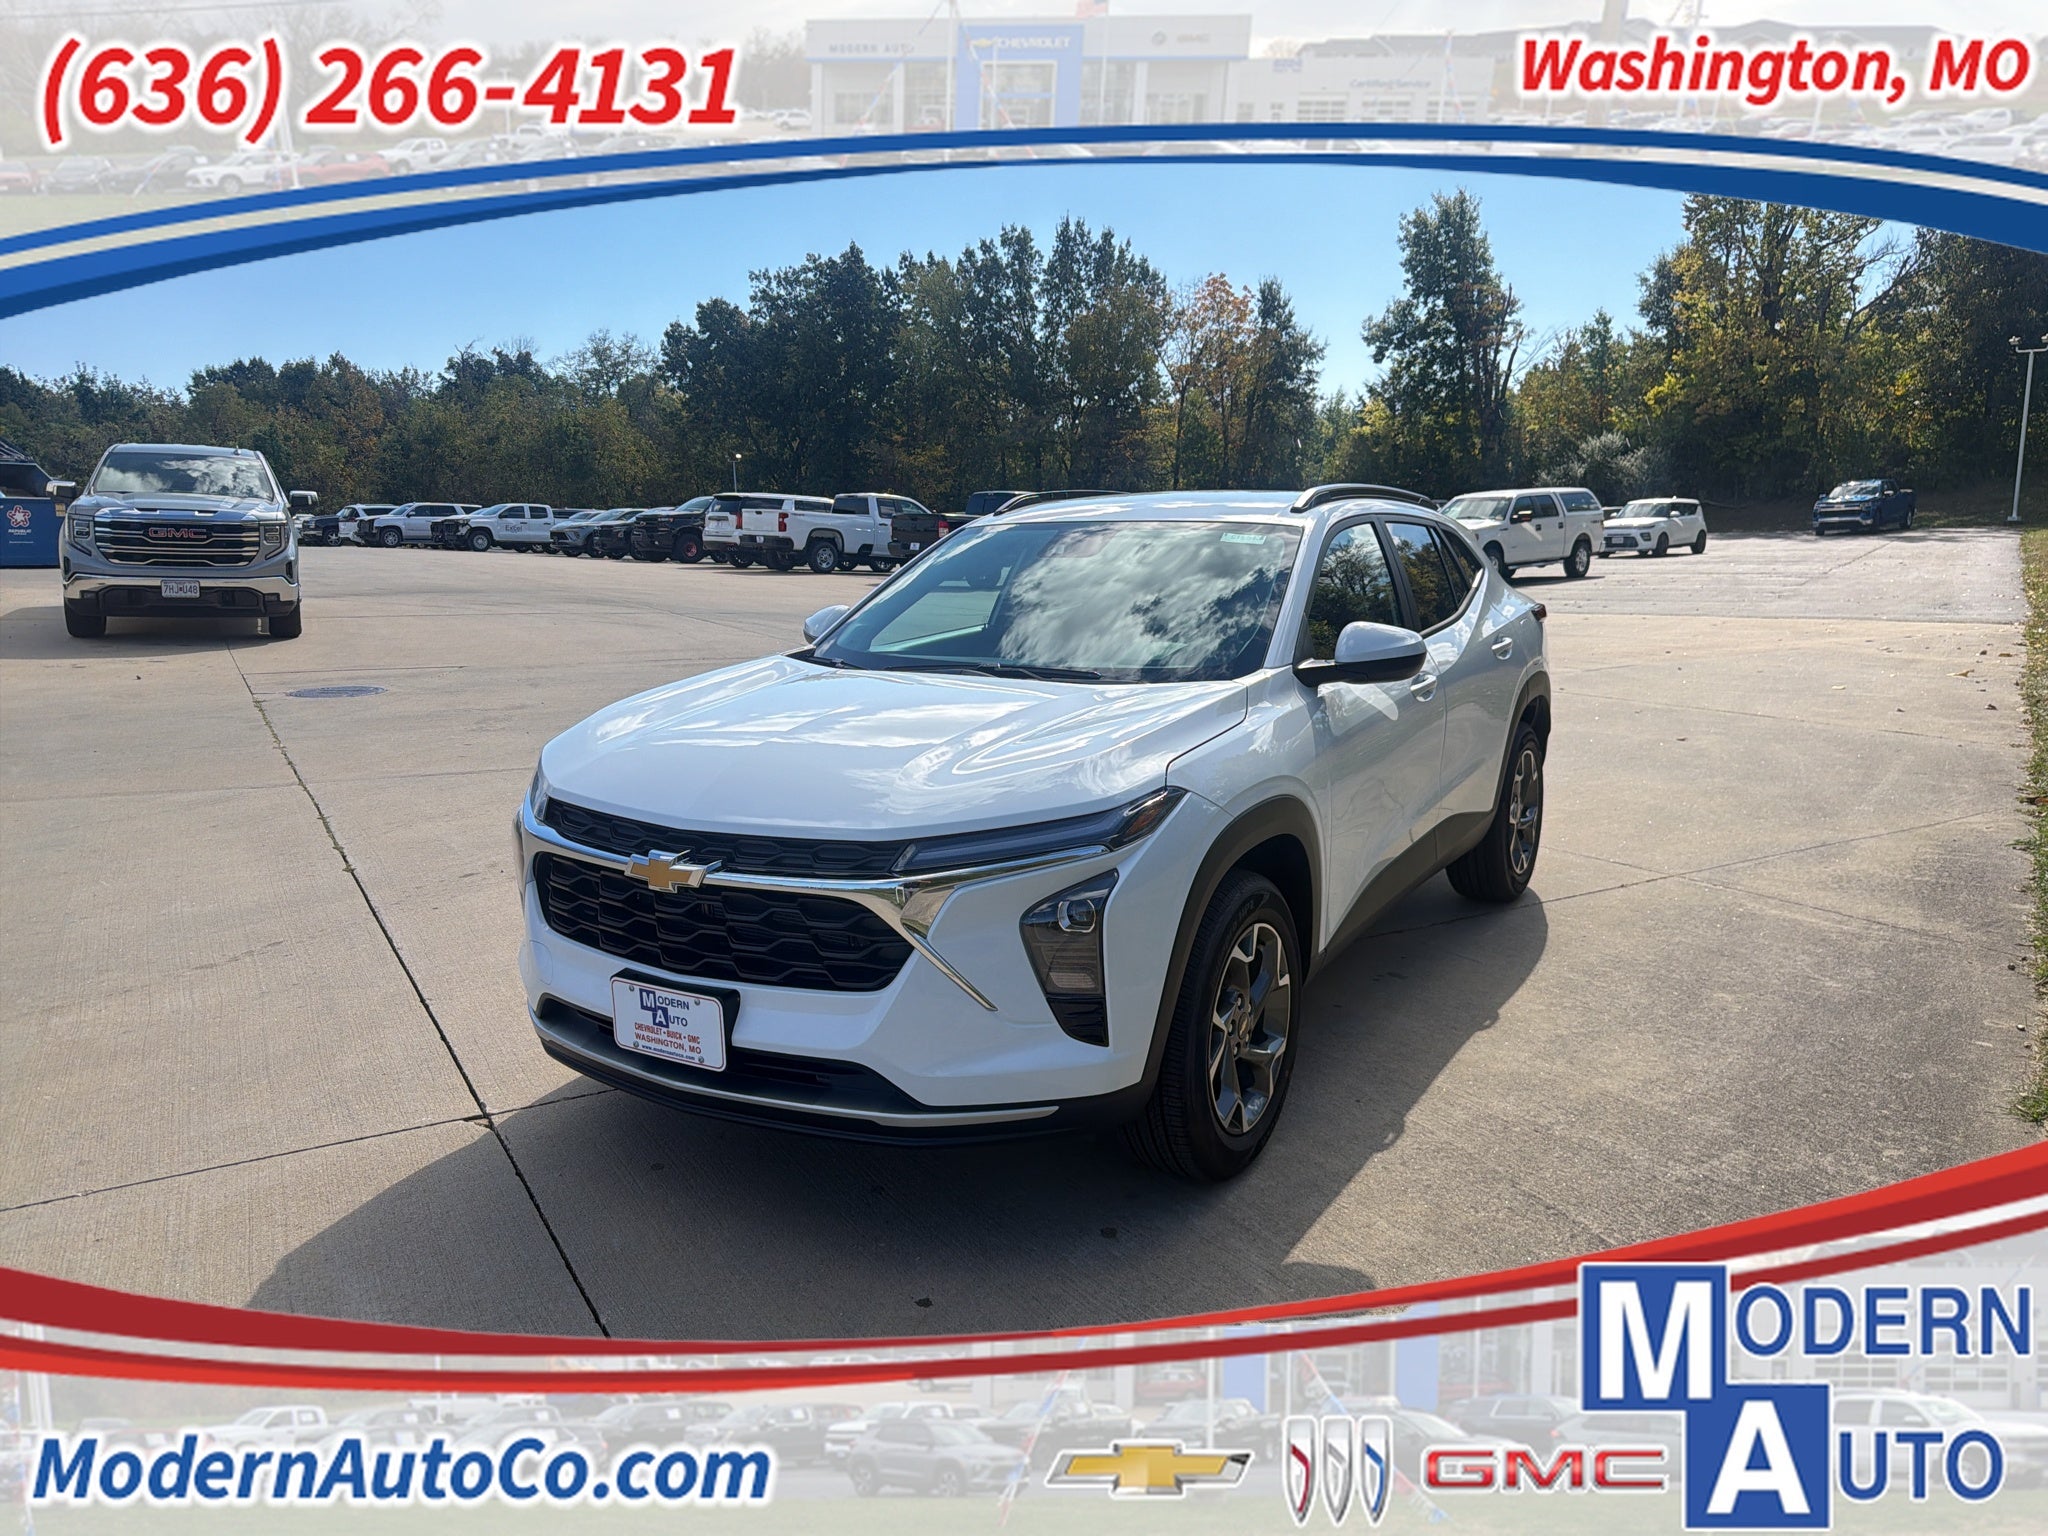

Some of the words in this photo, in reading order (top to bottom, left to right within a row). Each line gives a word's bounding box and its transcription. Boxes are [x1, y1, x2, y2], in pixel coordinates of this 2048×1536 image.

[148, 527, 207, 539] GMC
[641, 990, 690, 1011] MODERN
[655, 1008, 688, 1027] AUTO
[634, 1022, 662, 1036] CHEVROLET
[666, 1030, 682, 1041] BUICK
[687, 1034, 701, 1045] GMC
[634, 1031, 687, 1052] WASHINGTON,
[688, 1044, 702, 1055] MO
